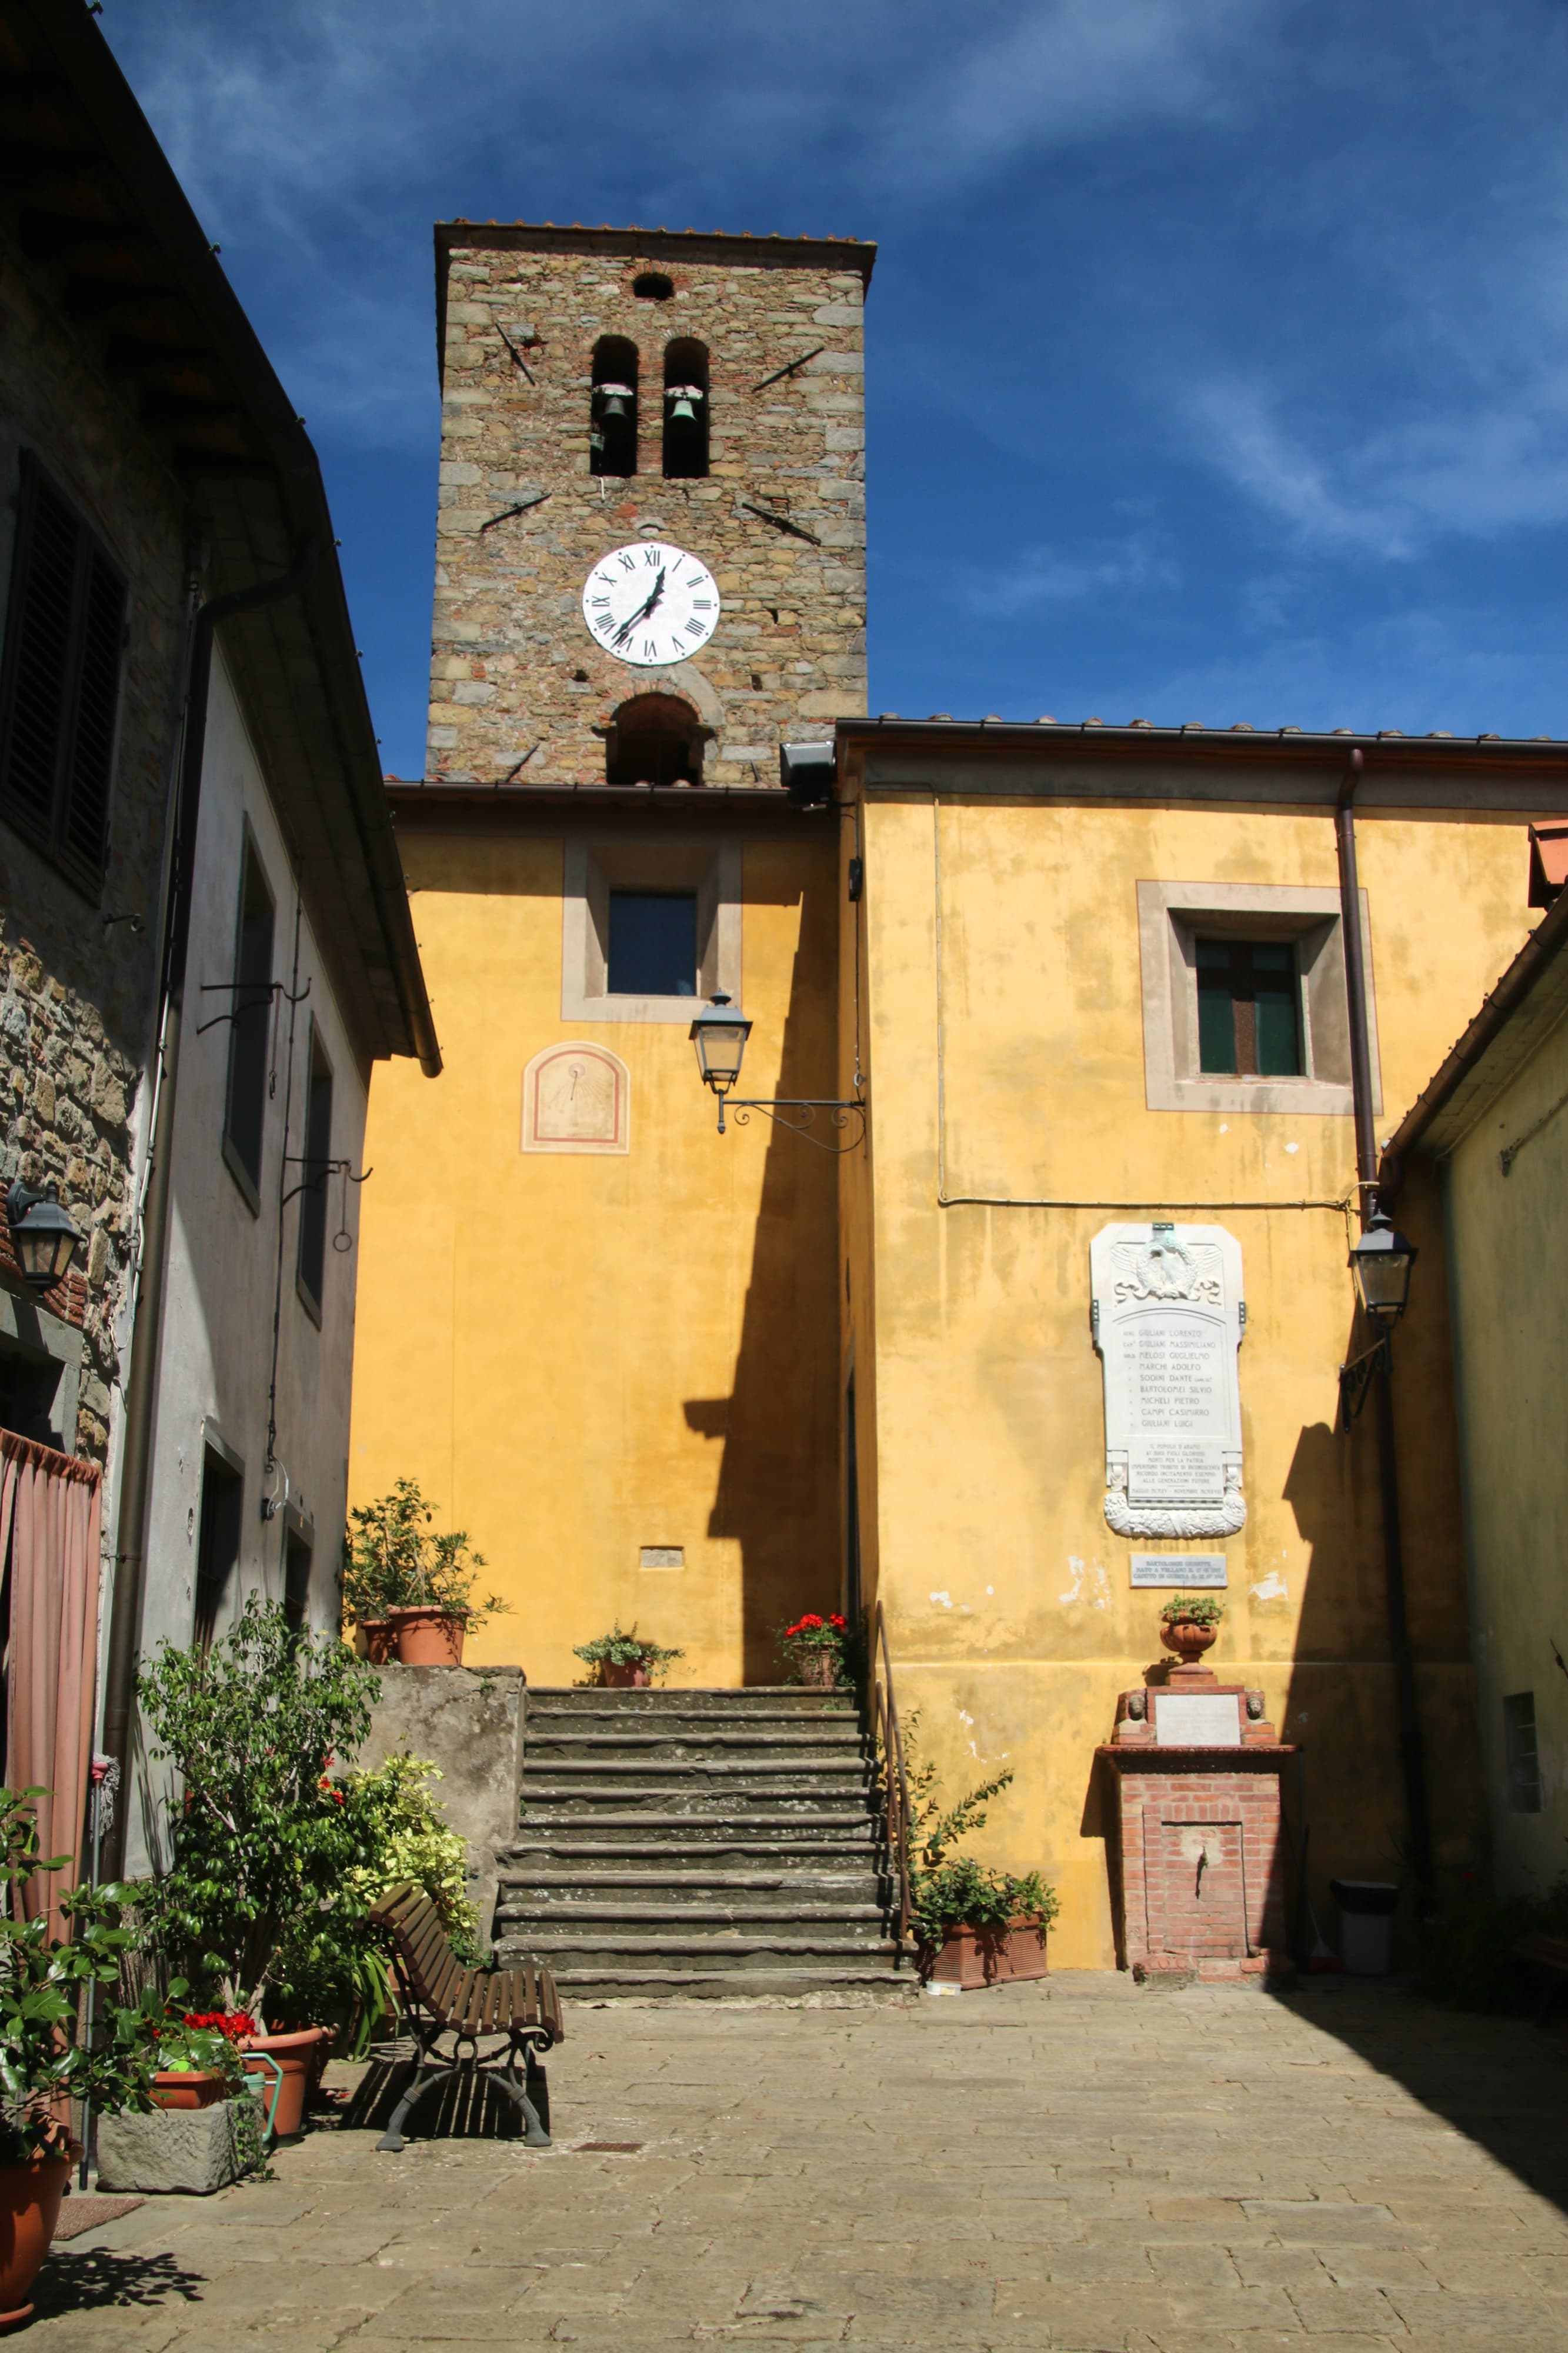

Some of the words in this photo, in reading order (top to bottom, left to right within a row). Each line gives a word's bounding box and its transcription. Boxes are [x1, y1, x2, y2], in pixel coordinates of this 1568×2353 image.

[618, 554, 636, 572] XI
[645, 550, 660, 566] XII
[672, 558, 682, 572] I
[598, 572, 617, 586] X
[686, 576, 705, 588] II
[591, 595, 610, 606] IX
[693, 600, 711, 609] III
[595, 613, 617, 635] VIII
[645, 640, 657, 656] VI
[672, 636, 685, 652] V
